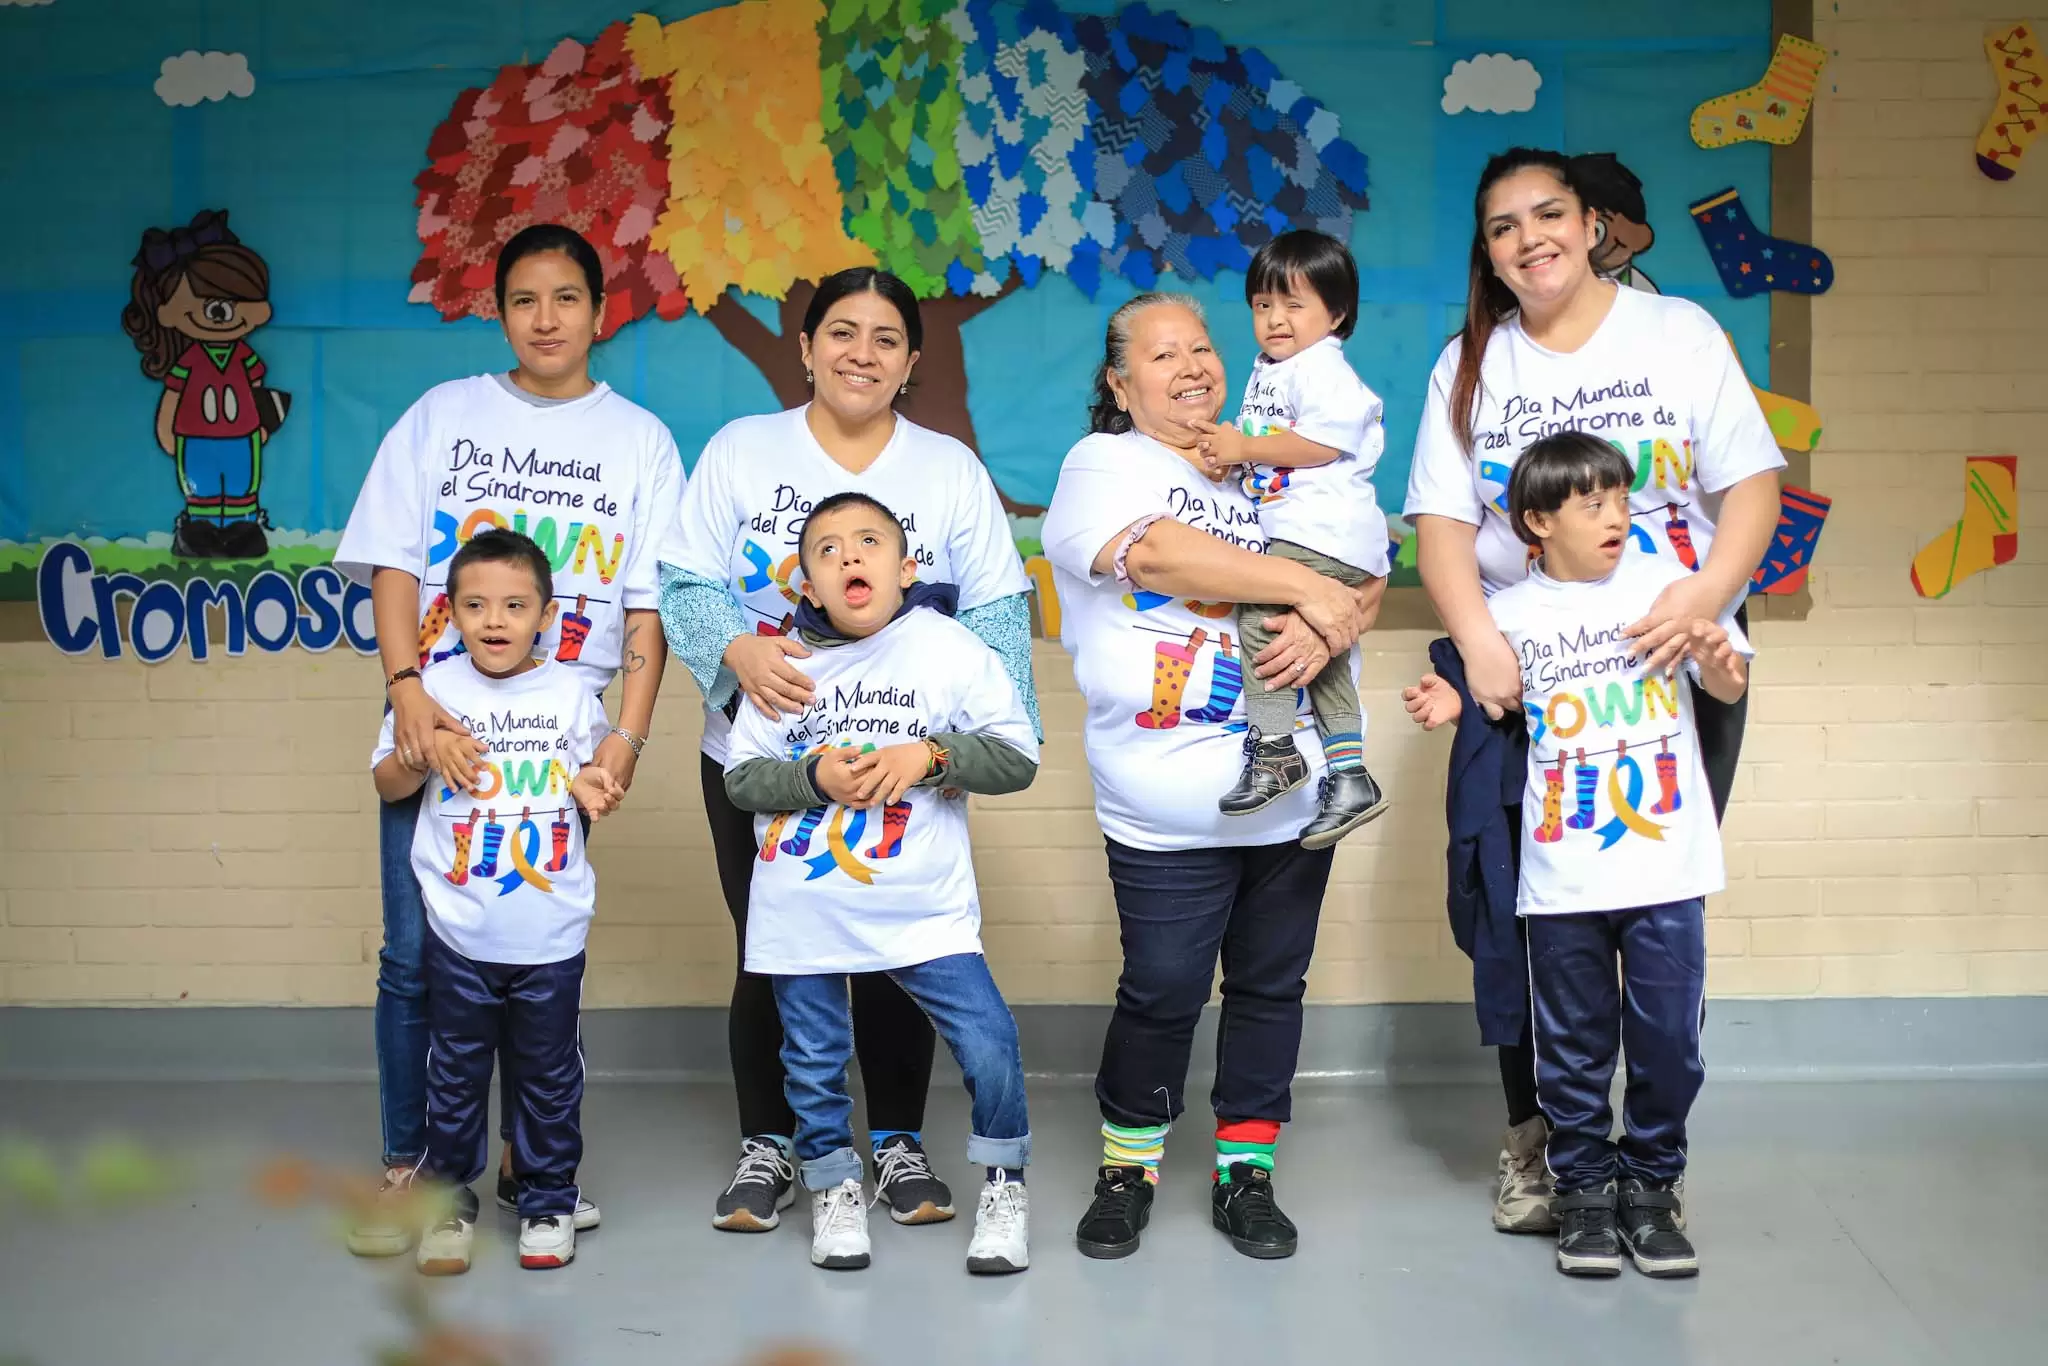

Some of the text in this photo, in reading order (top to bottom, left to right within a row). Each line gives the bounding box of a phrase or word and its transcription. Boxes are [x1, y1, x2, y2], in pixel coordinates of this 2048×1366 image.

[1500, 377, 1653, 425] Día Mundial
[1484, 405, 1677, 451] del Síndrome de
[449, 438, 602, 483] Día Mundial
[441, 471, 618, 517] el Síndrome de
[770, 484, 812, 513] Día
[751, 512, 777, 535] del
[915, 543, 935, 566] de
[1521, 624, 1627, 671] Día Mund
[1522, 655, 1638, 694] el Síndrome
[835, 680, 916, 713] Mundial
[1523, 674, 1680, 745] DOWN
[490, 709, 559, 734] Mundial
[786, 725, 813, 744] del
[908, 718, 928, 738] de
[478, 734, 569, 753] ndrome de
